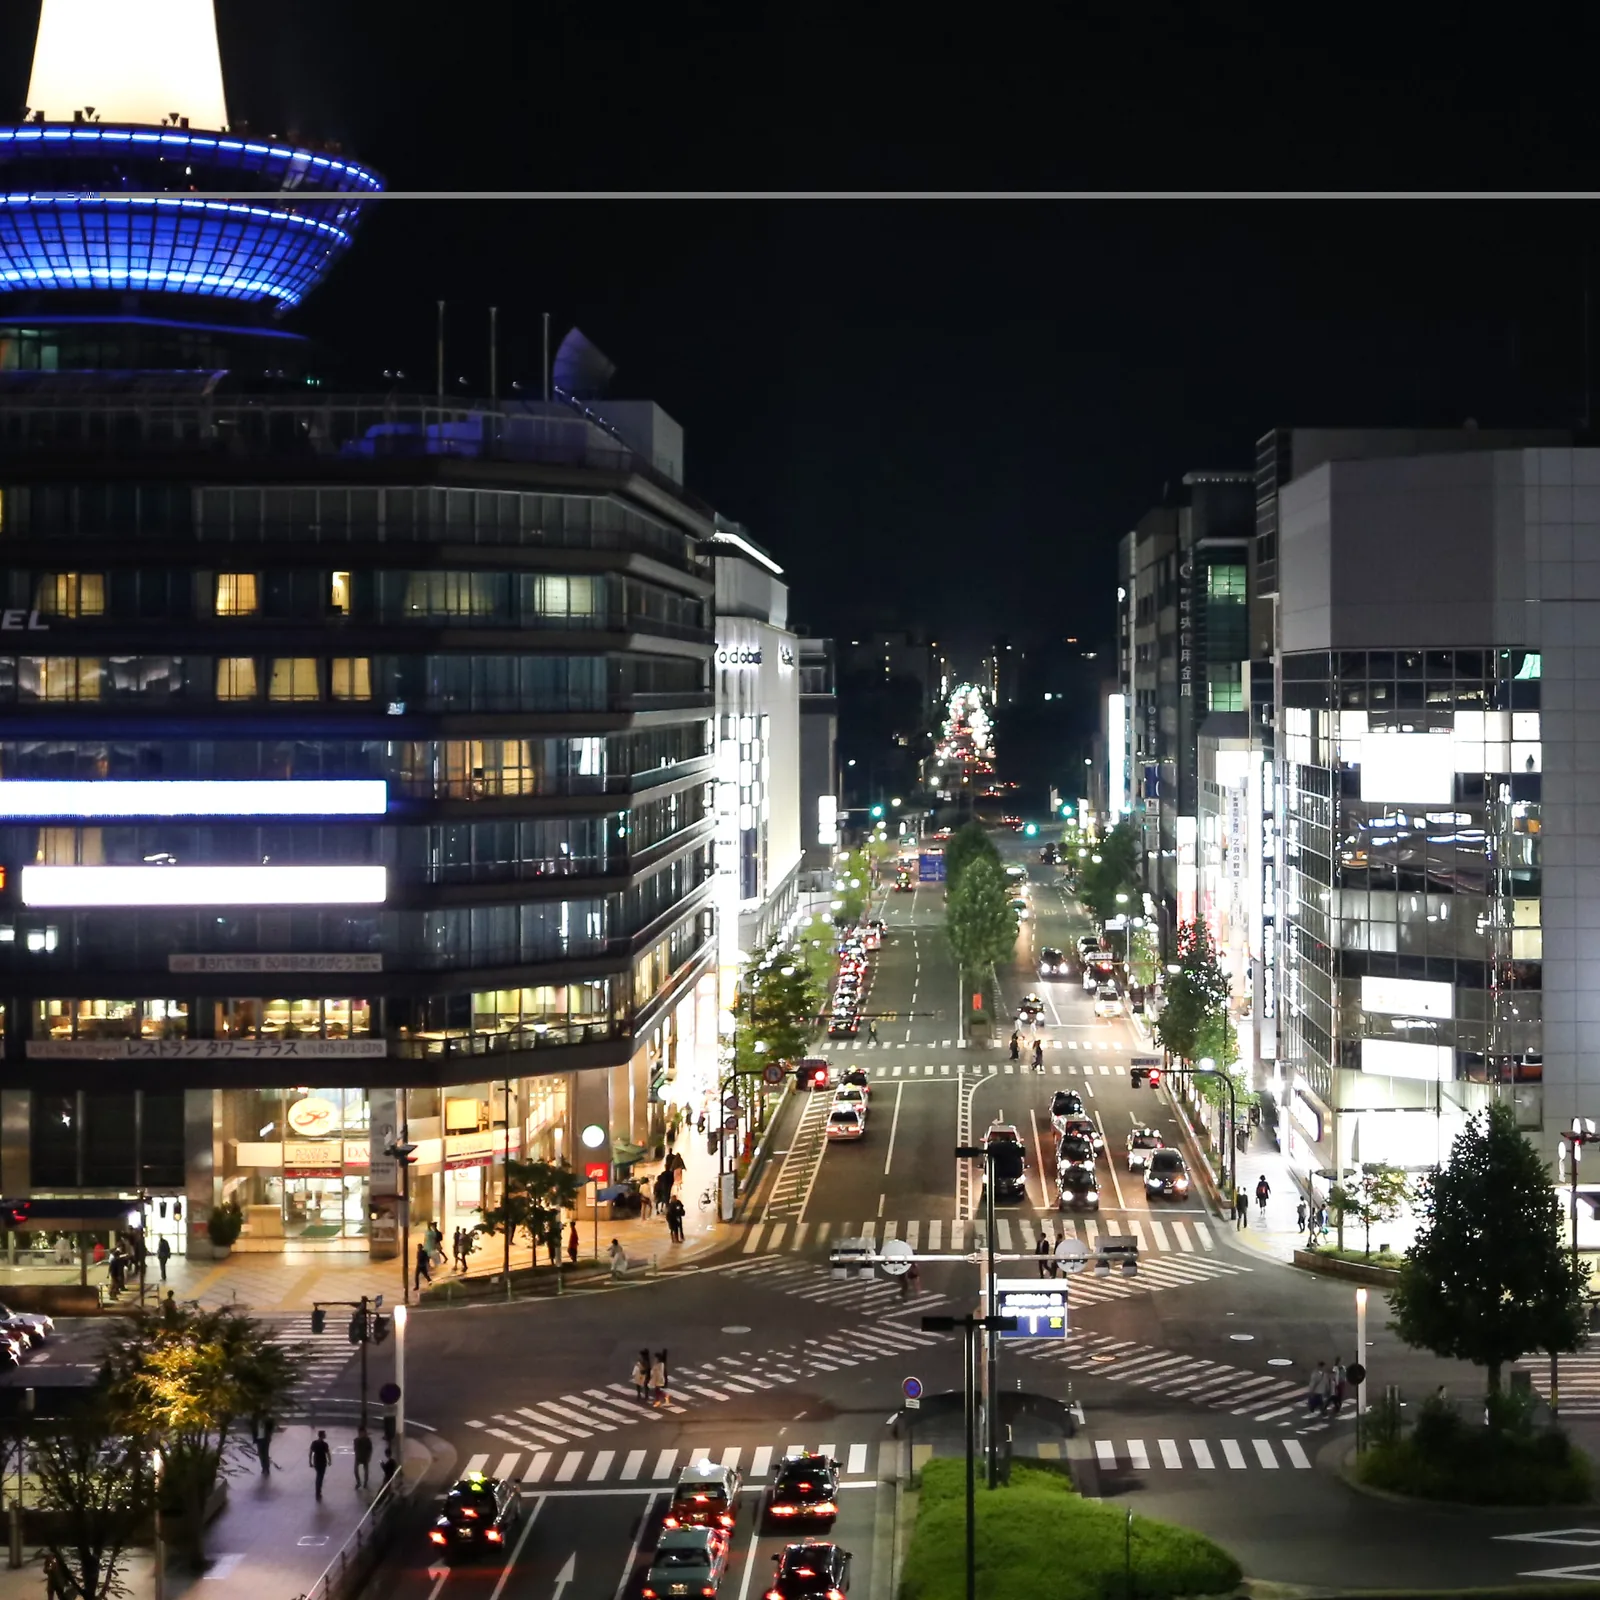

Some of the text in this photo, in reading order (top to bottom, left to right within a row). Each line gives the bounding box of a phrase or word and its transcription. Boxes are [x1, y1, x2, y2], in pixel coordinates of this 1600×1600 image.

[0, 608, 50, 631] EL
[127, 1041, 199, 1057] レストラン
[206, 1041, 299, 1056] タワーテラス
